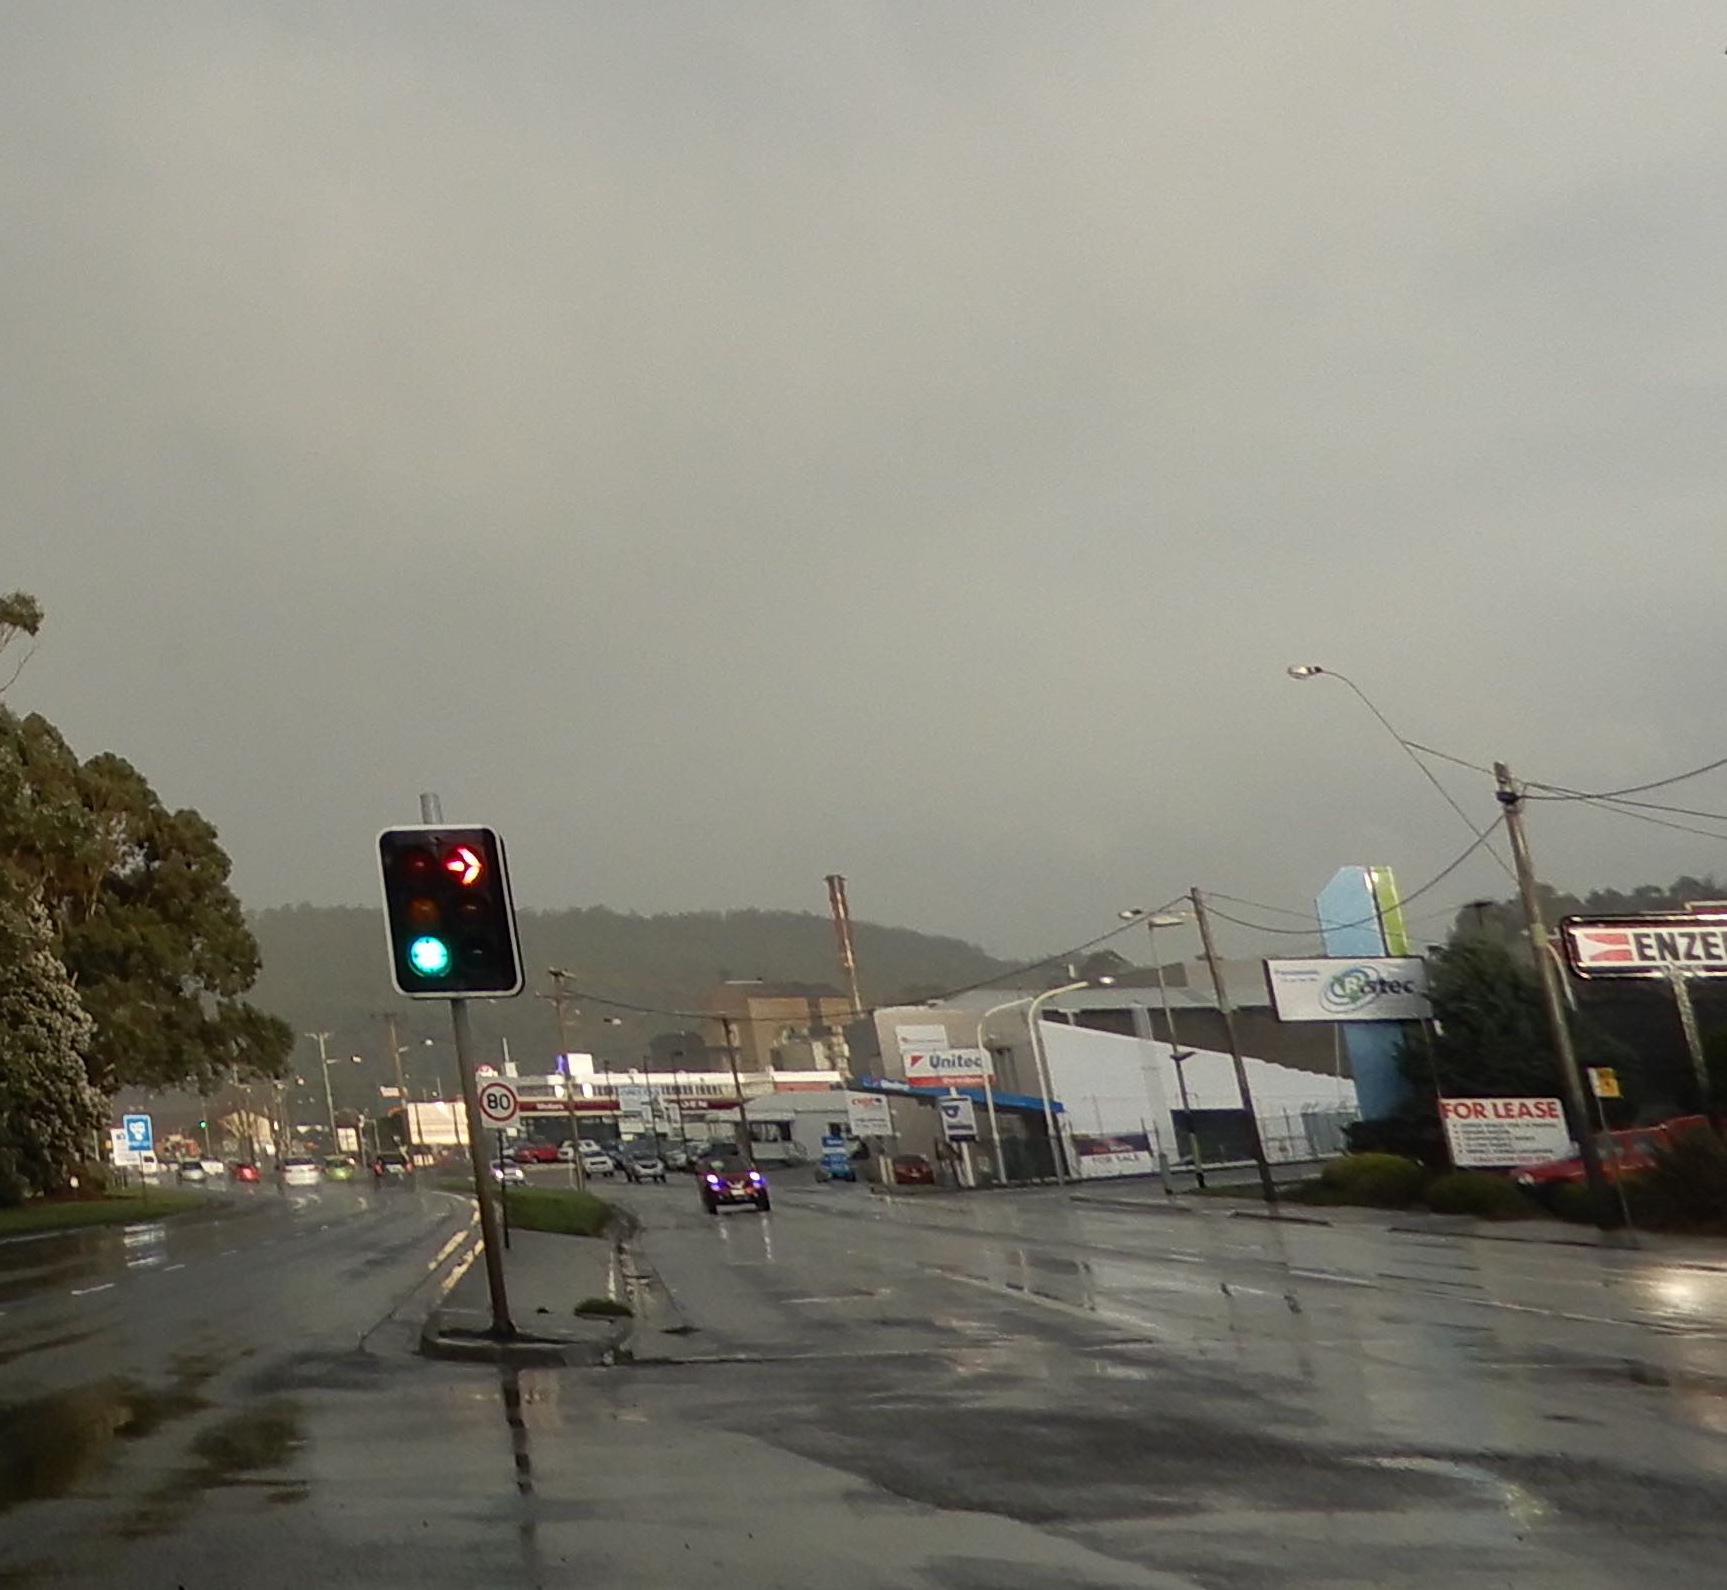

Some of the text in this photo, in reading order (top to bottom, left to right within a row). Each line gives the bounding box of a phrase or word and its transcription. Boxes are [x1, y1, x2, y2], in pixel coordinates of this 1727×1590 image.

[929, 1055, 983, 1069] Unitec
[486, 1092, 511, 1111] 80
[1440, 1101, 1560, 1119] FOR LEASE
